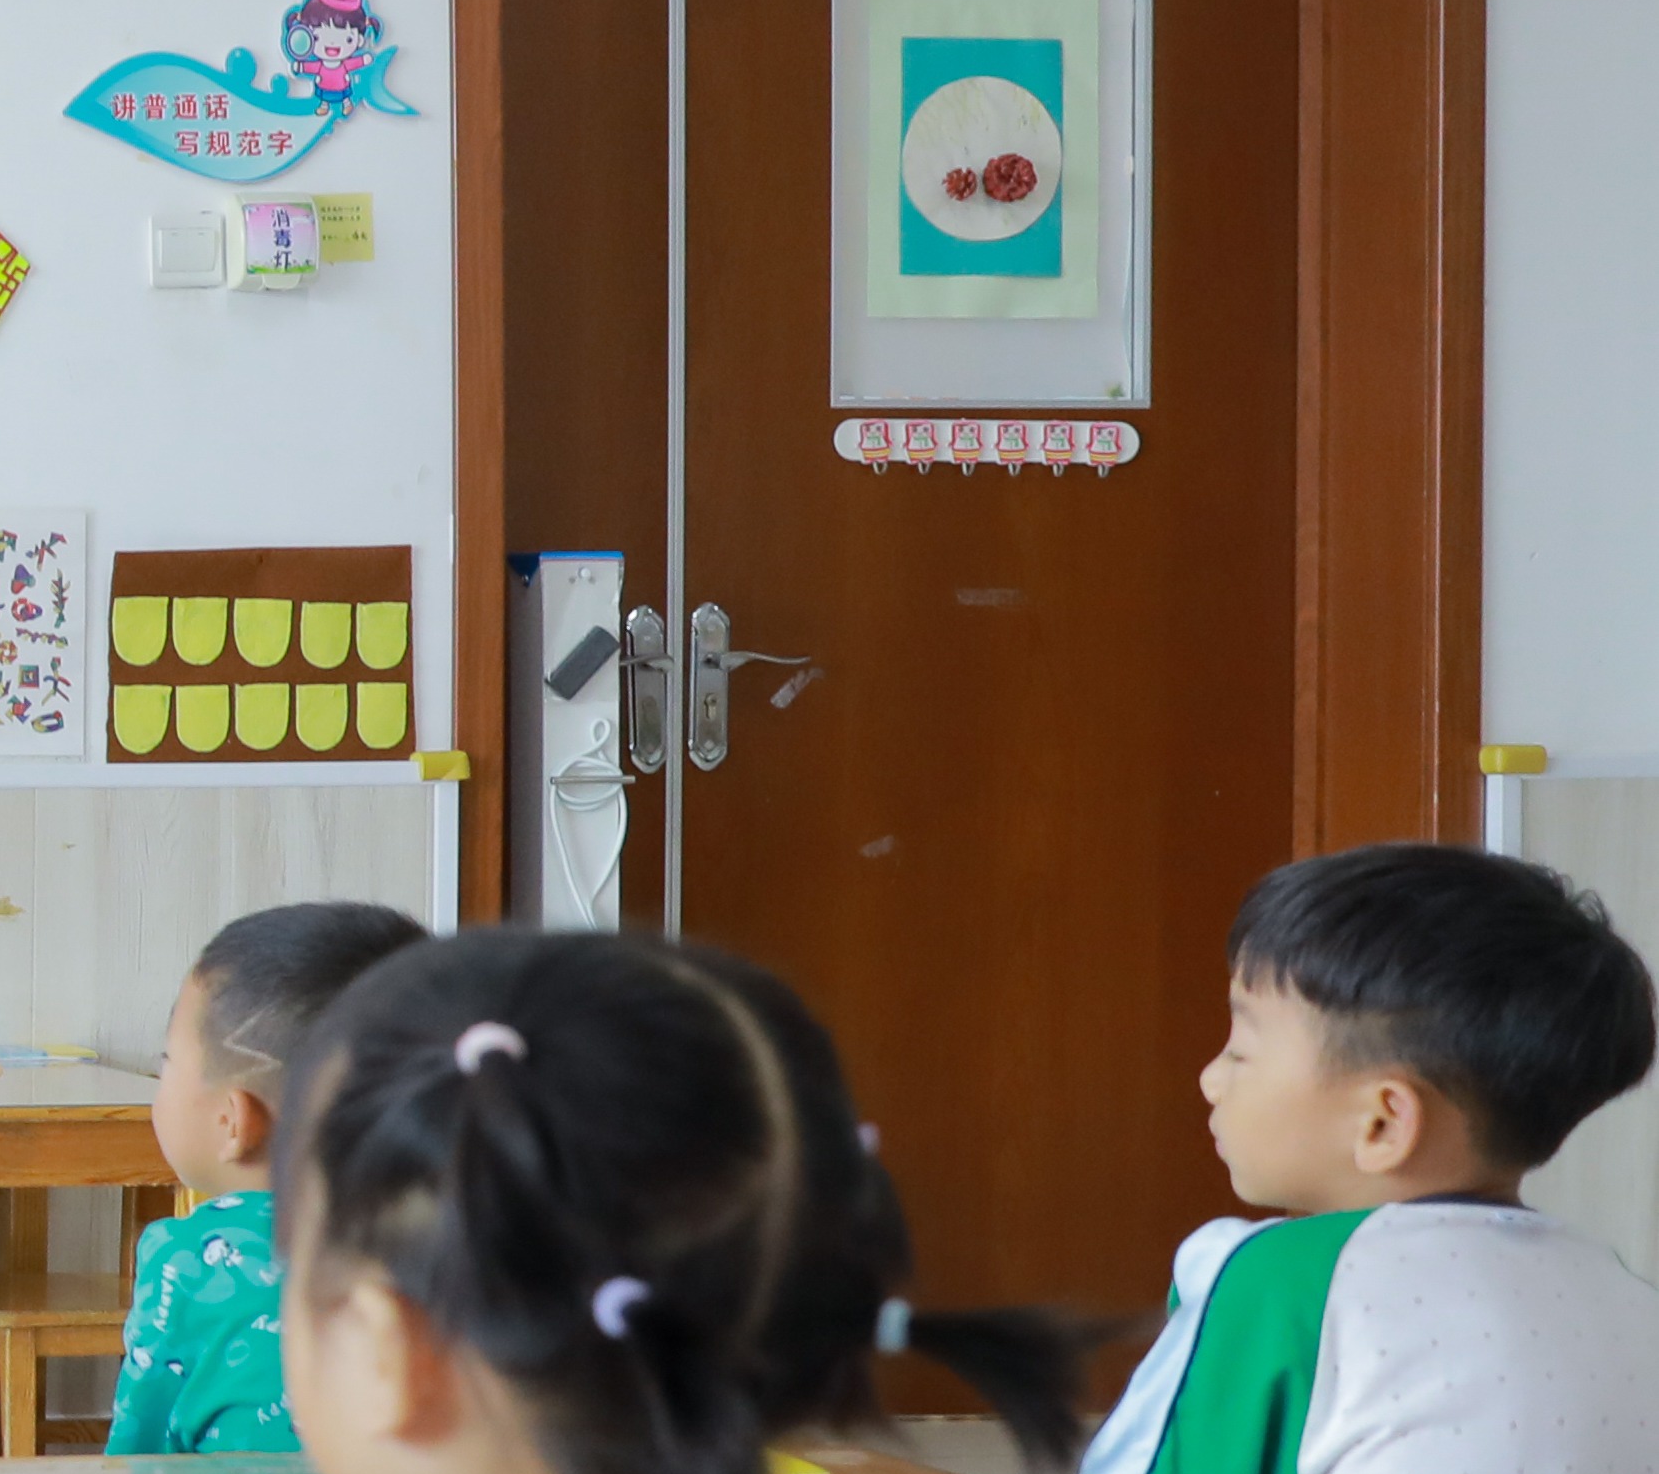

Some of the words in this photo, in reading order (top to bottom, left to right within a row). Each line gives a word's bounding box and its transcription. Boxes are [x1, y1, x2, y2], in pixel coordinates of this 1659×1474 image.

[110, 93, 229, 120] 讲普通话
[176, 131, 293, 156] 写规范字
[272, 208, 292, 272] 消毒灯
